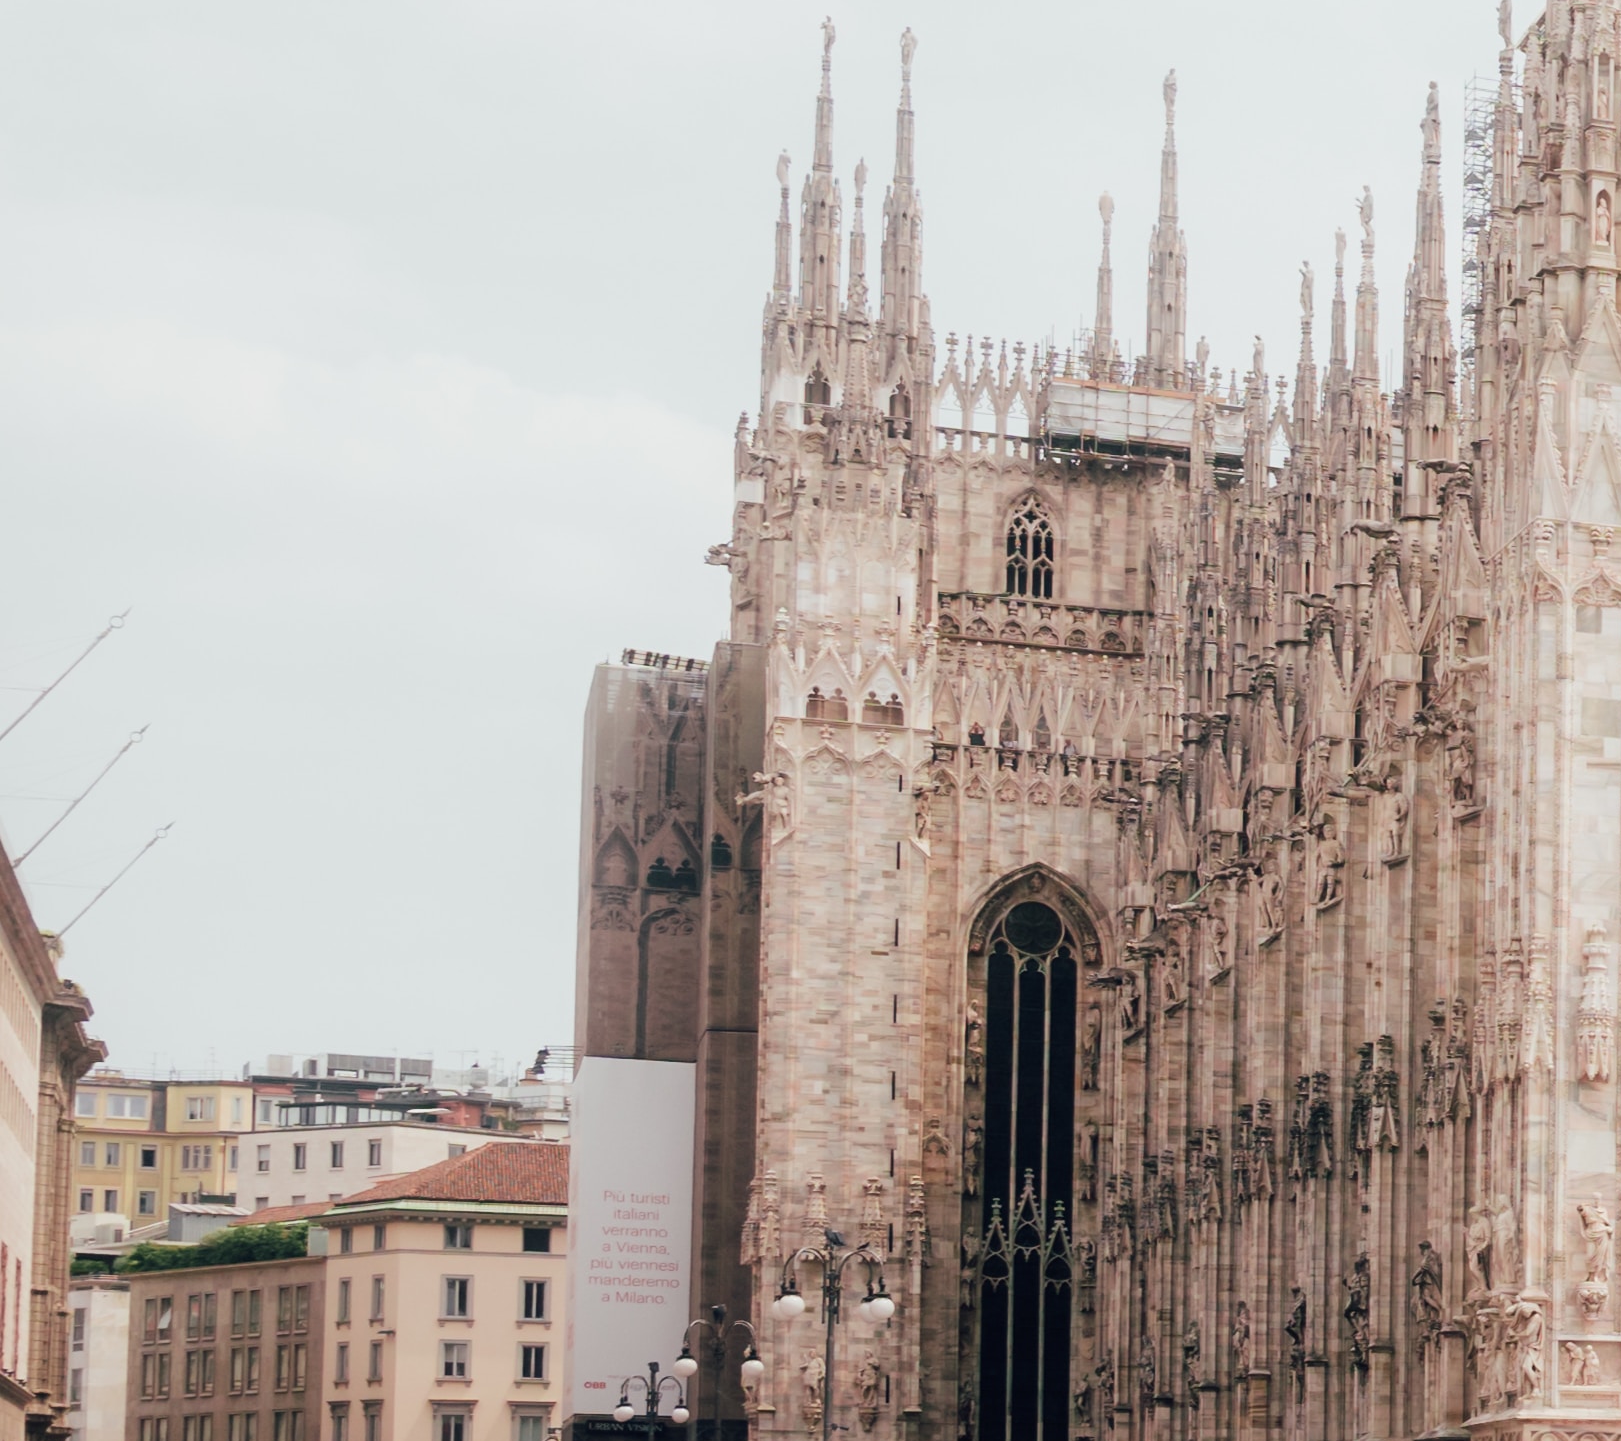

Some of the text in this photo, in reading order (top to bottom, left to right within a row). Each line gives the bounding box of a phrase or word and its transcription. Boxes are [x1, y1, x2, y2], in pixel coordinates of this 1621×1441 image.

[630, 1193, 670, 1205] turisti
[614, 1208, 660, 1220] italiani
[602, 1226, 668, 1238] verranno
[602, 1242, 611, 1252] a
[618, 1260, 679, 1271] viennesi
[588, 1275, 680, 1289] manderemo
[601, 1293, 610, 1302] a
